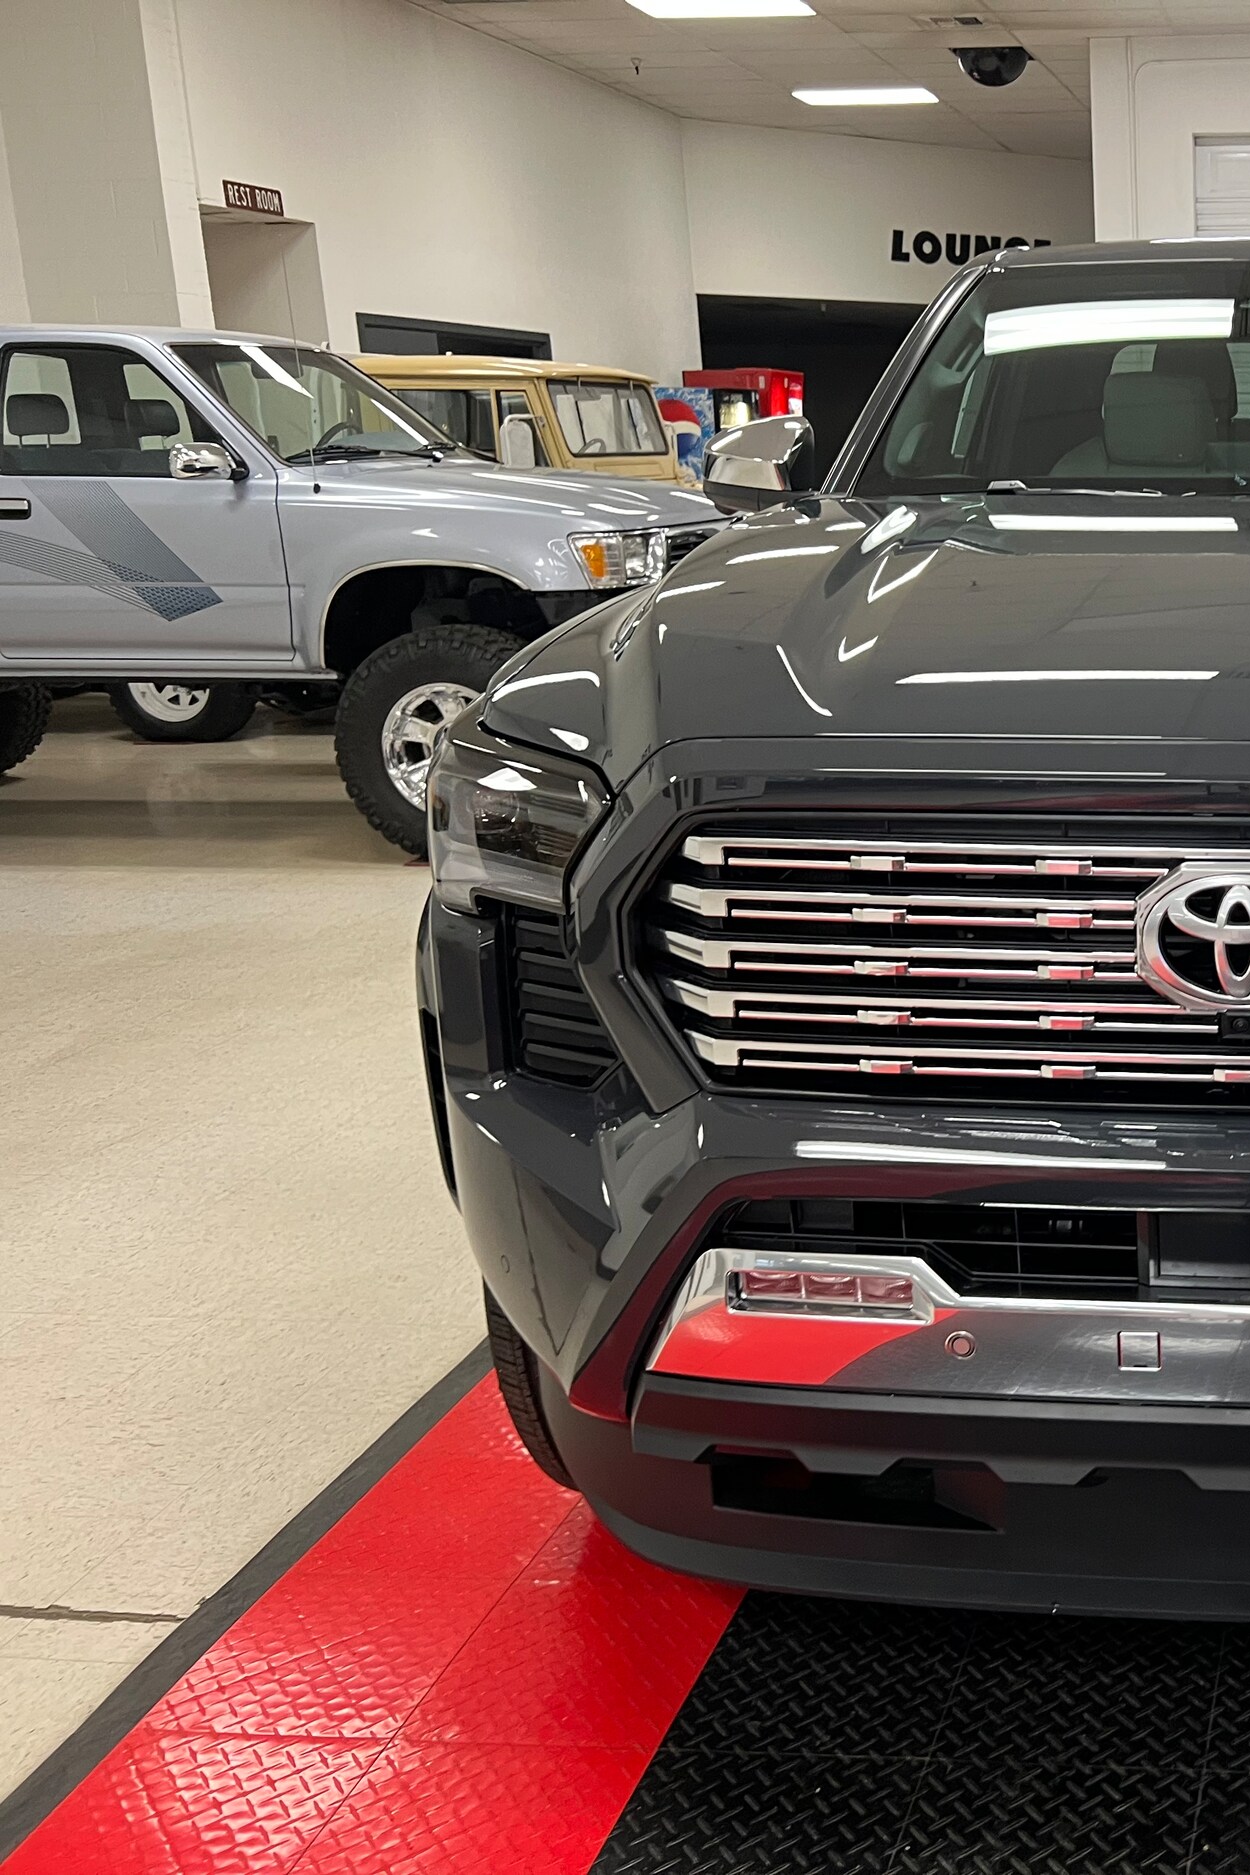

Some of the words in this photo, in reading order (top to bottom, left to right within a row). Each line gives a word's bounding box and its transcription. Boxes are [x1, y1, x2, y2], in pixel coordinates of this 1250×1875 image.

[227, 184, 252, 207] REST
[255, 189, 281, 212] ROOM
[891, 229, 1051, 266] LOUN
